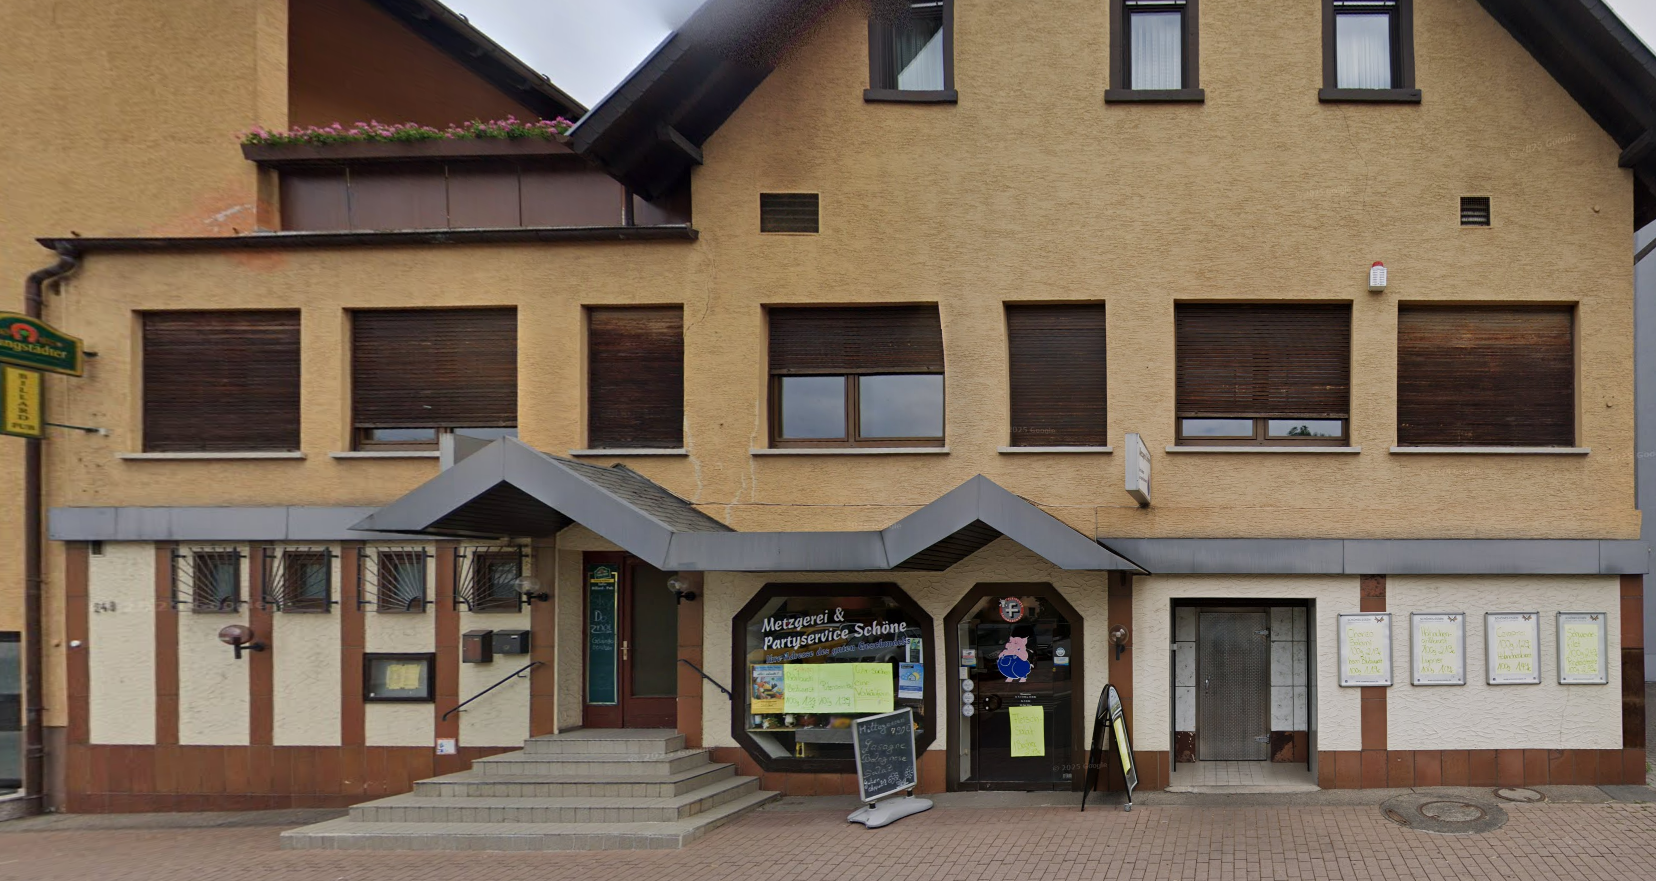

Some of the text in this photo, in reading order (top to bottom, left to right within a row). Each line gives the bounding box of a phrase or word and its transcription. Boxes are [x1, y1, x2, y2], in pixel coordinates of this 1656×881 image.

[11, 422, 36, 432] PUB
[761, 607, 845, 633] Metzgerei &
[763, 620, 907, 651] Partyservice Schöne
[858, 636, 911, 651] Geschmacks
[861, 739, 907, 754] Lasagne
